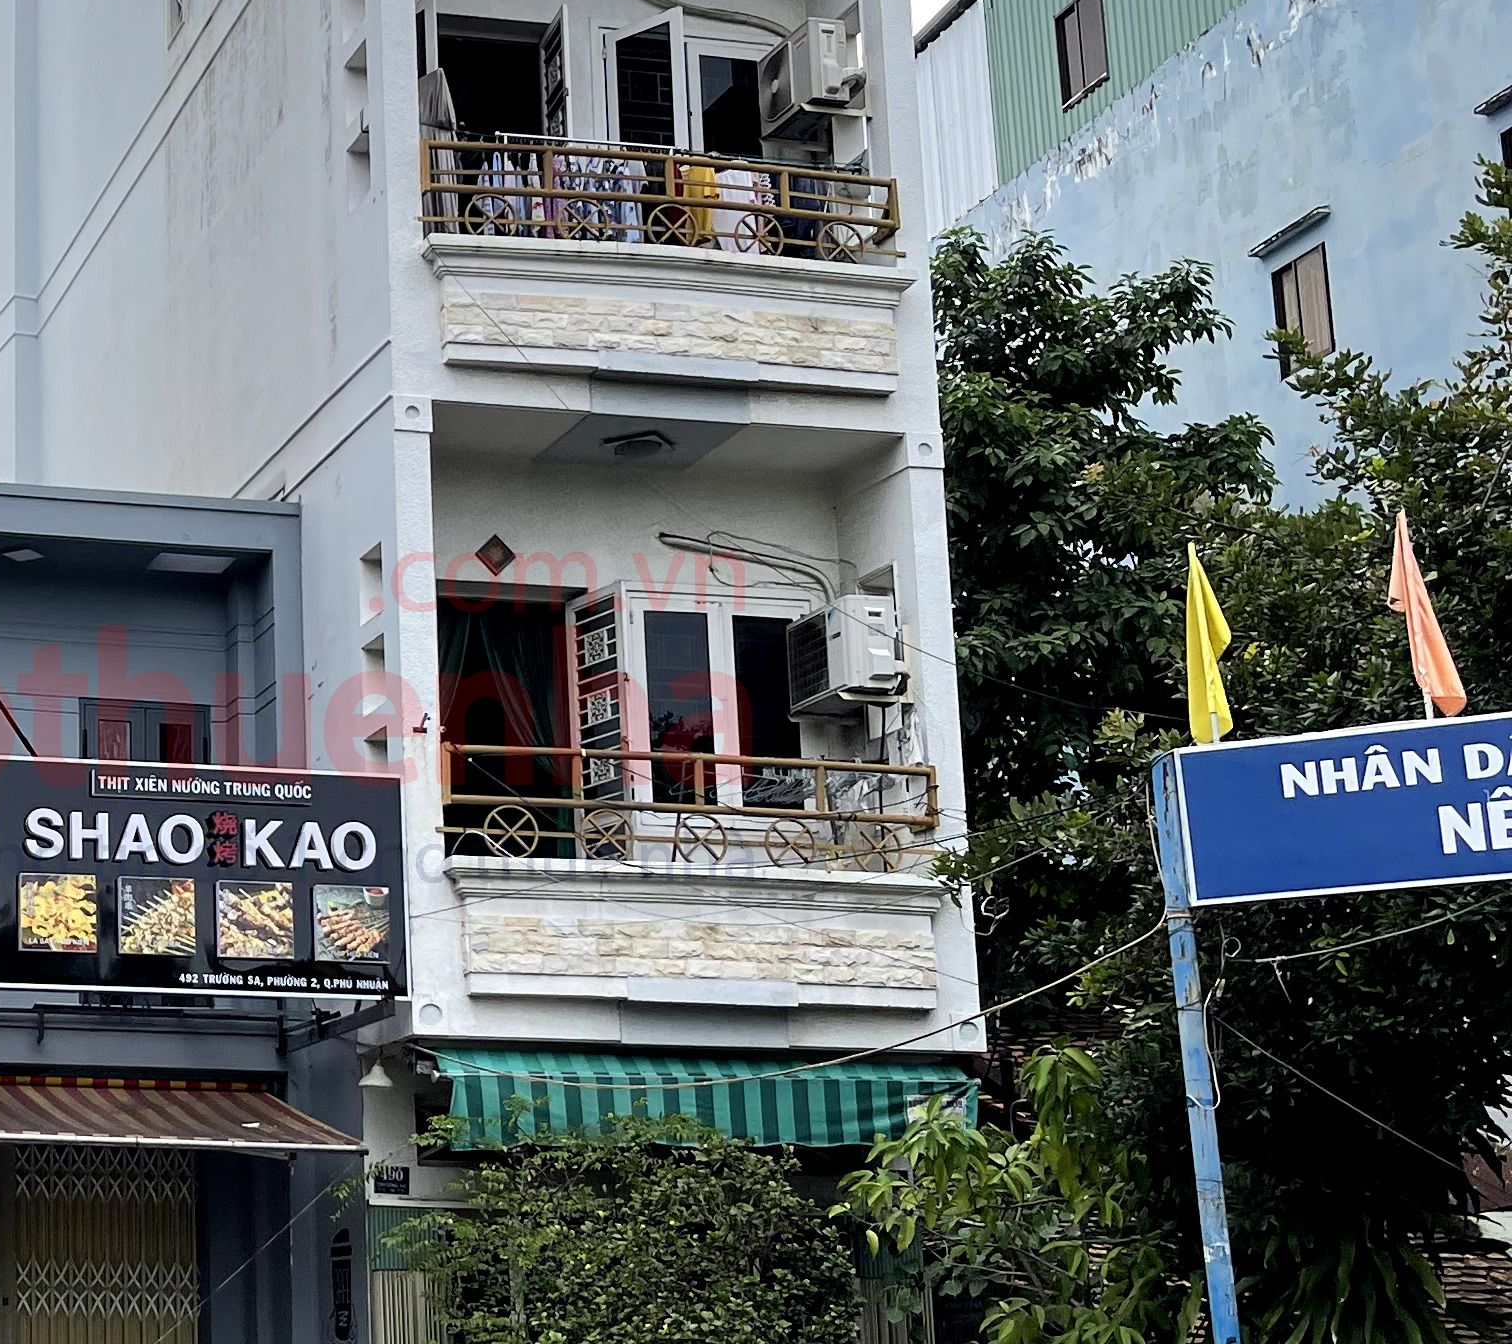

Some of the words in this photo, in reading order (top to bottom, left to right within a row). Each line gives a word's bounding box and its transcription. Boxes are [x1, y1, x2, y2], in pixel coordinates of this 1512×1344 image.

[97, 775, 130, 794] THỊT
[135, 774, 167, 792] XIÊN
[172, 776, 220, 795] NƯỚNG
[224, 781, 270, 797] TRUNG
[274, 780, 312, 800] QUỐC
[1279, 744, 1443, 799] NHÂN
[24, 807, 205, 864] SHAO
[243, 818, 377, 871] KAO
[179, 973, 199, 984] 492
[203, 972, 243, 985] TRƯỜNG
[247, 976, 264, 987] SA,
[267, 974, 307, 987] PHƯỜNG
[311, 979, 320, 989] 2,
